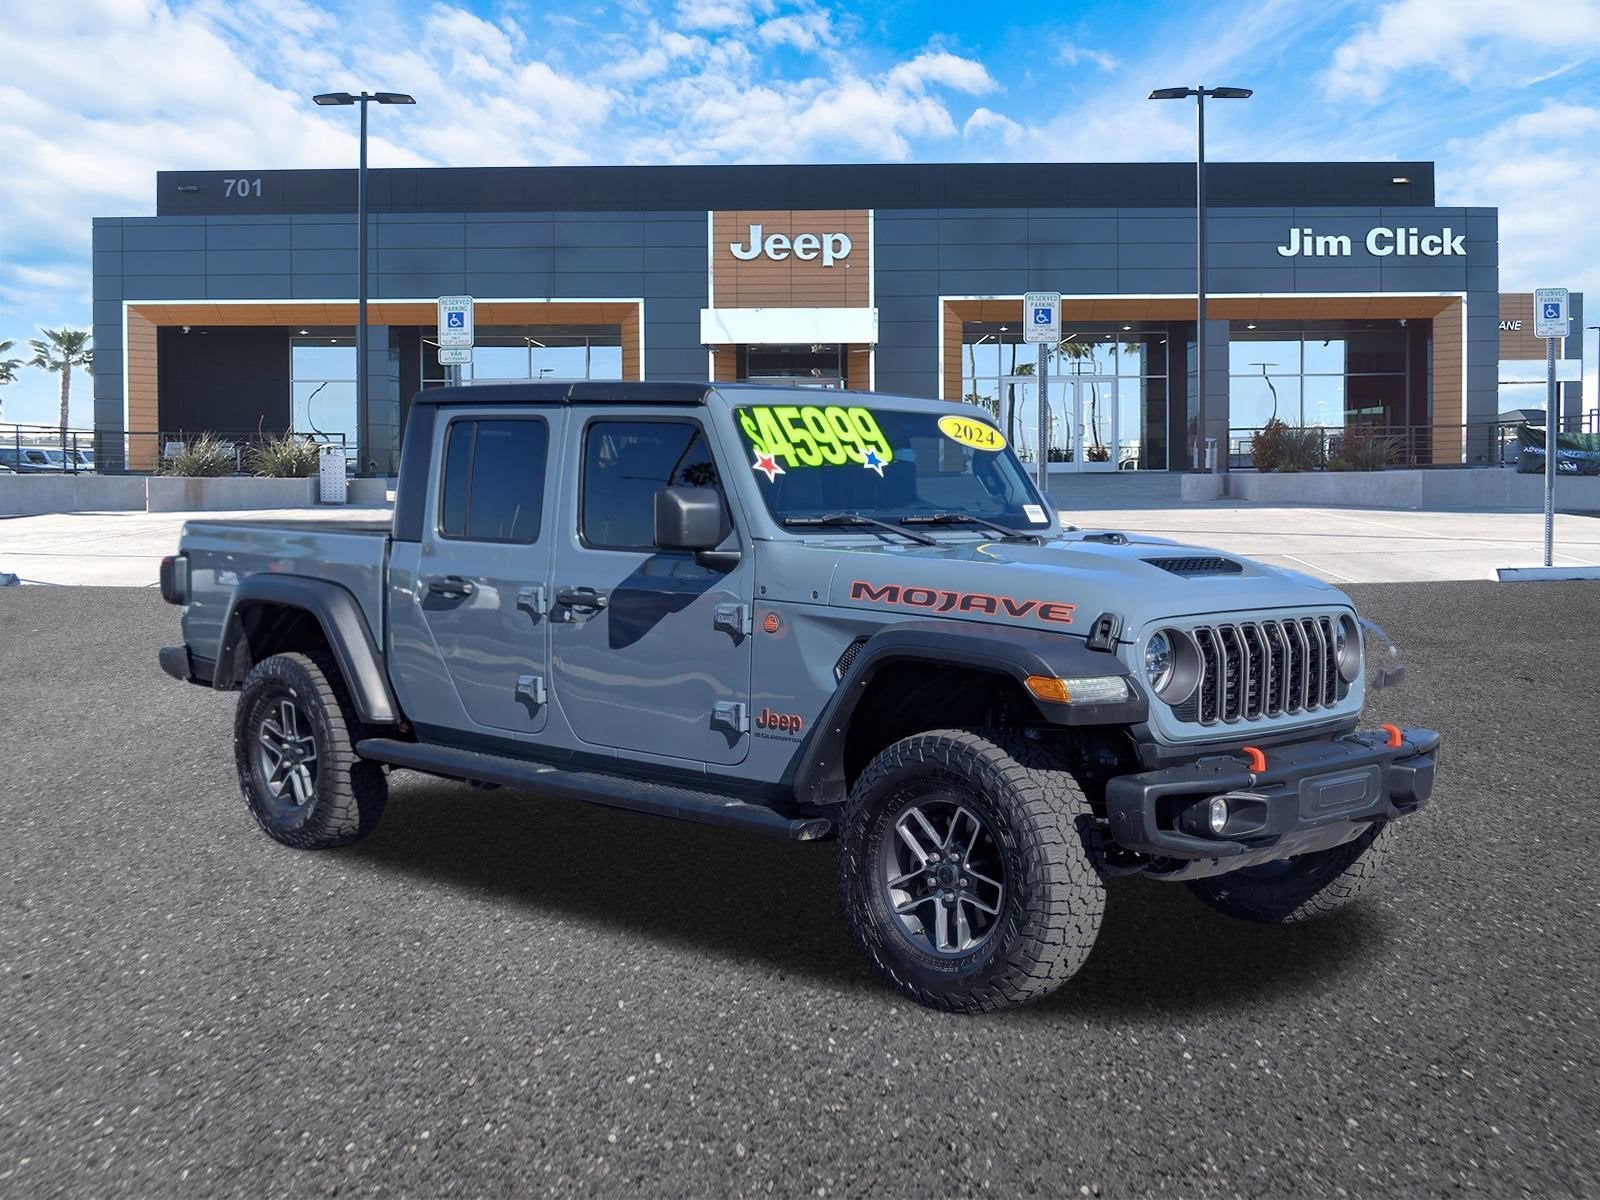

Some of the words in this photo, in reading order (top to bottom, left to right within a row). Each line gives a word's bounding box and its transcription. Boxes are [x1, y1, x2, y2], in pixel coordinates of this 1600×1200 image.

[223, 178, 262, 197] 701
[729, 223, 852, 268] Jeep
[1277, 228, 1351, 256] Jim
[1366, 227, 1467, 256] Click
[738, 406, 894, 468] $45999
[953, 422, 996, 446] 2024
[850, 580, 1077, 625] MOJAVE
[755, 707, 803, 736] Jeep
